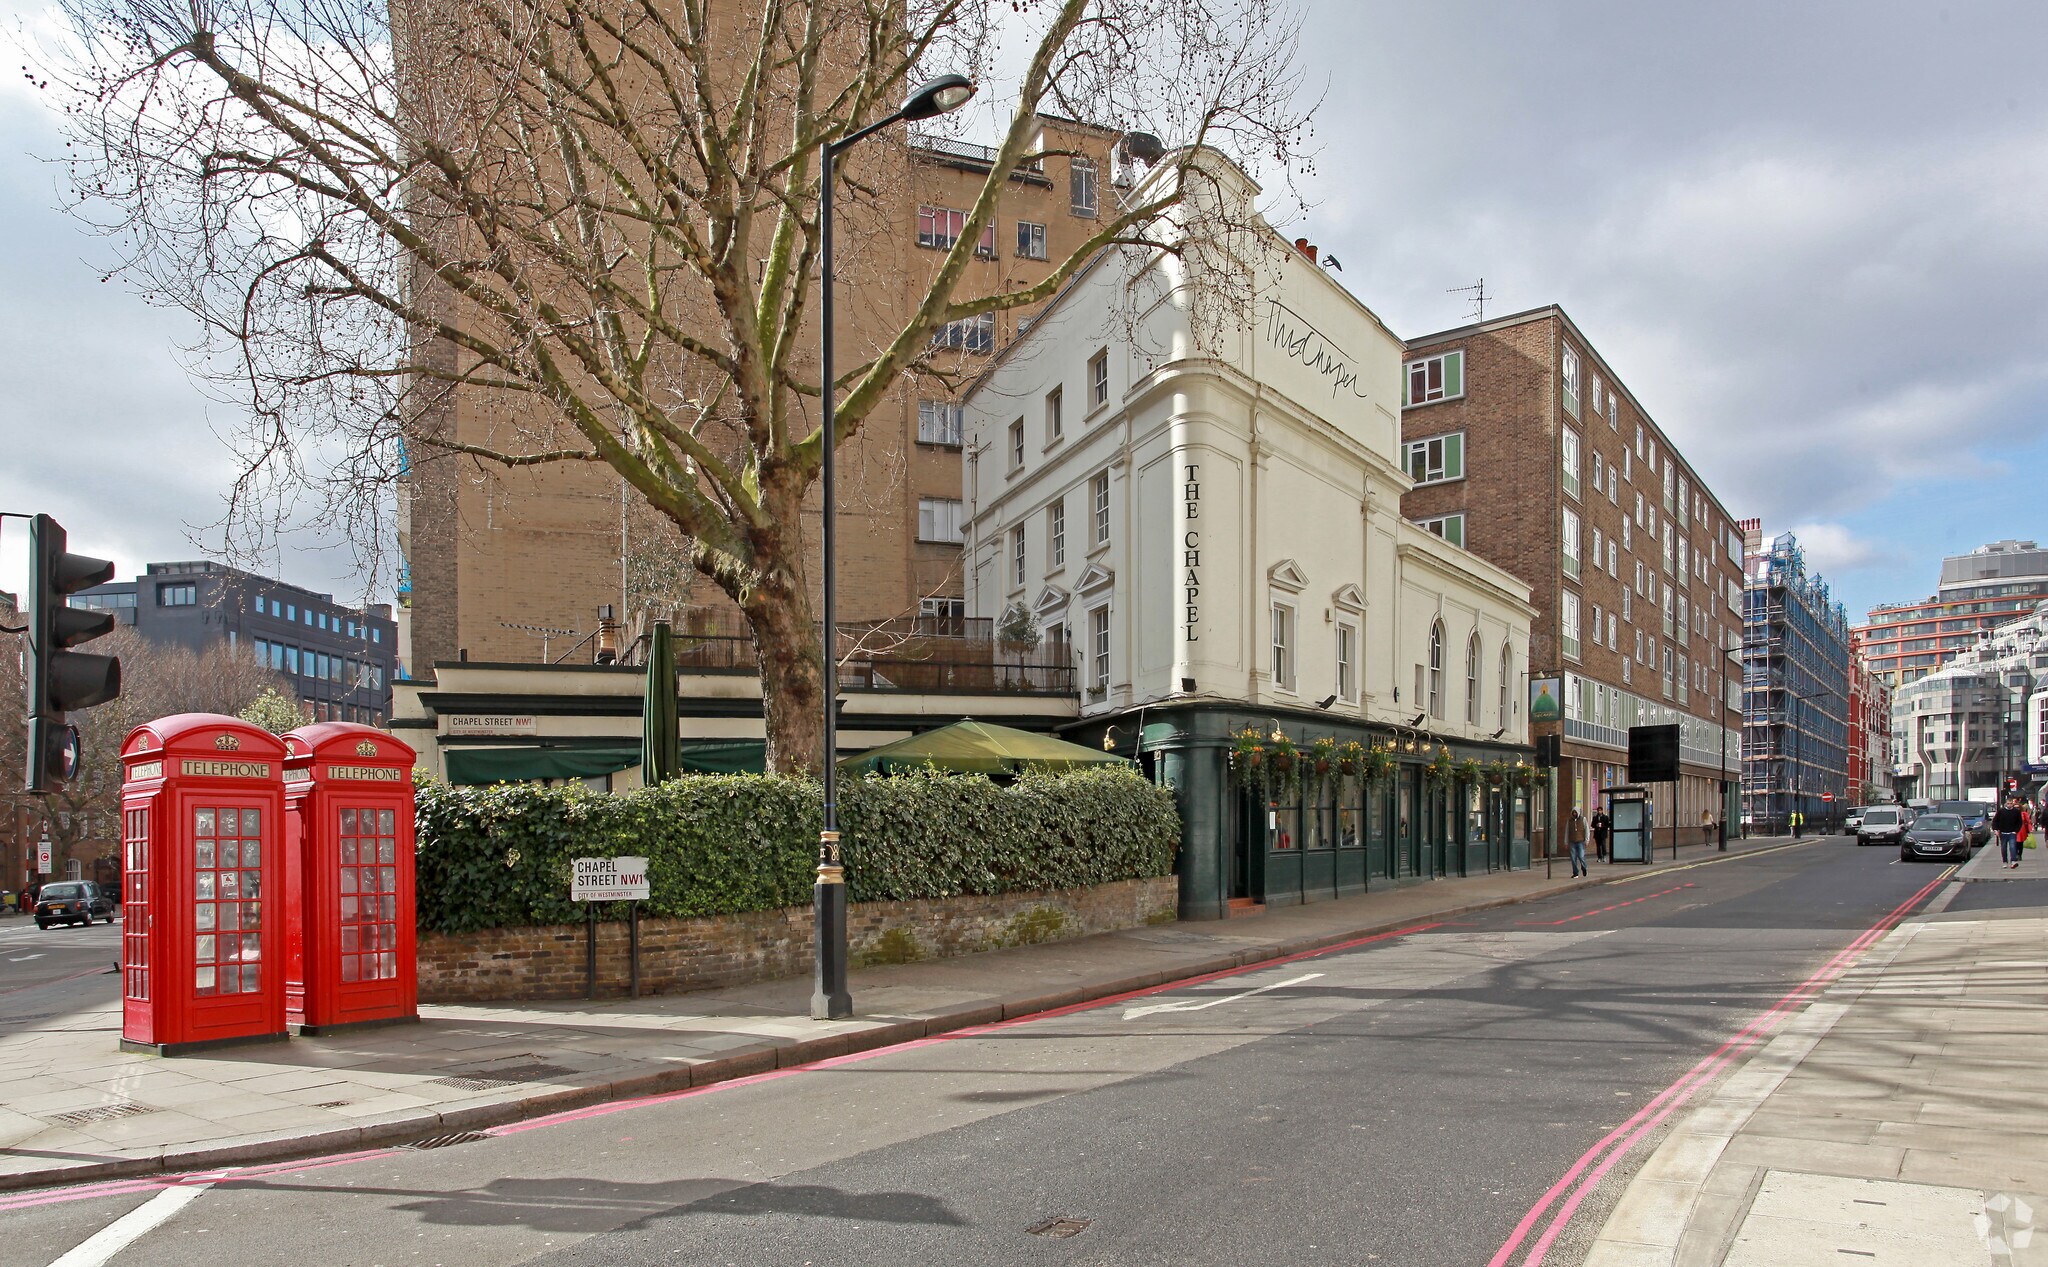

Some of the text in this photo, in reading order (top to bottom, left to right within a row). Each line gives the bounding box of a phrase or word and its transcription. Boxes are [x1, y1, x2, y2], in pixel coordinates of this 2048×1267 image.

[1184, 464, 1200, 642] THE CHAPEL
[453, 717, 482, 725] CHAPEL
[485, 717, 512, 725] STREET
[132, 761, 162, 779] TELEPHONE
[183, 761, 268, 777] TELEPHONE
[329, 767, 400, 780] TELEPHONE
[577, 861, 617, 873] CHAPEL
[578, 873, 643, 886] STREET NW1
